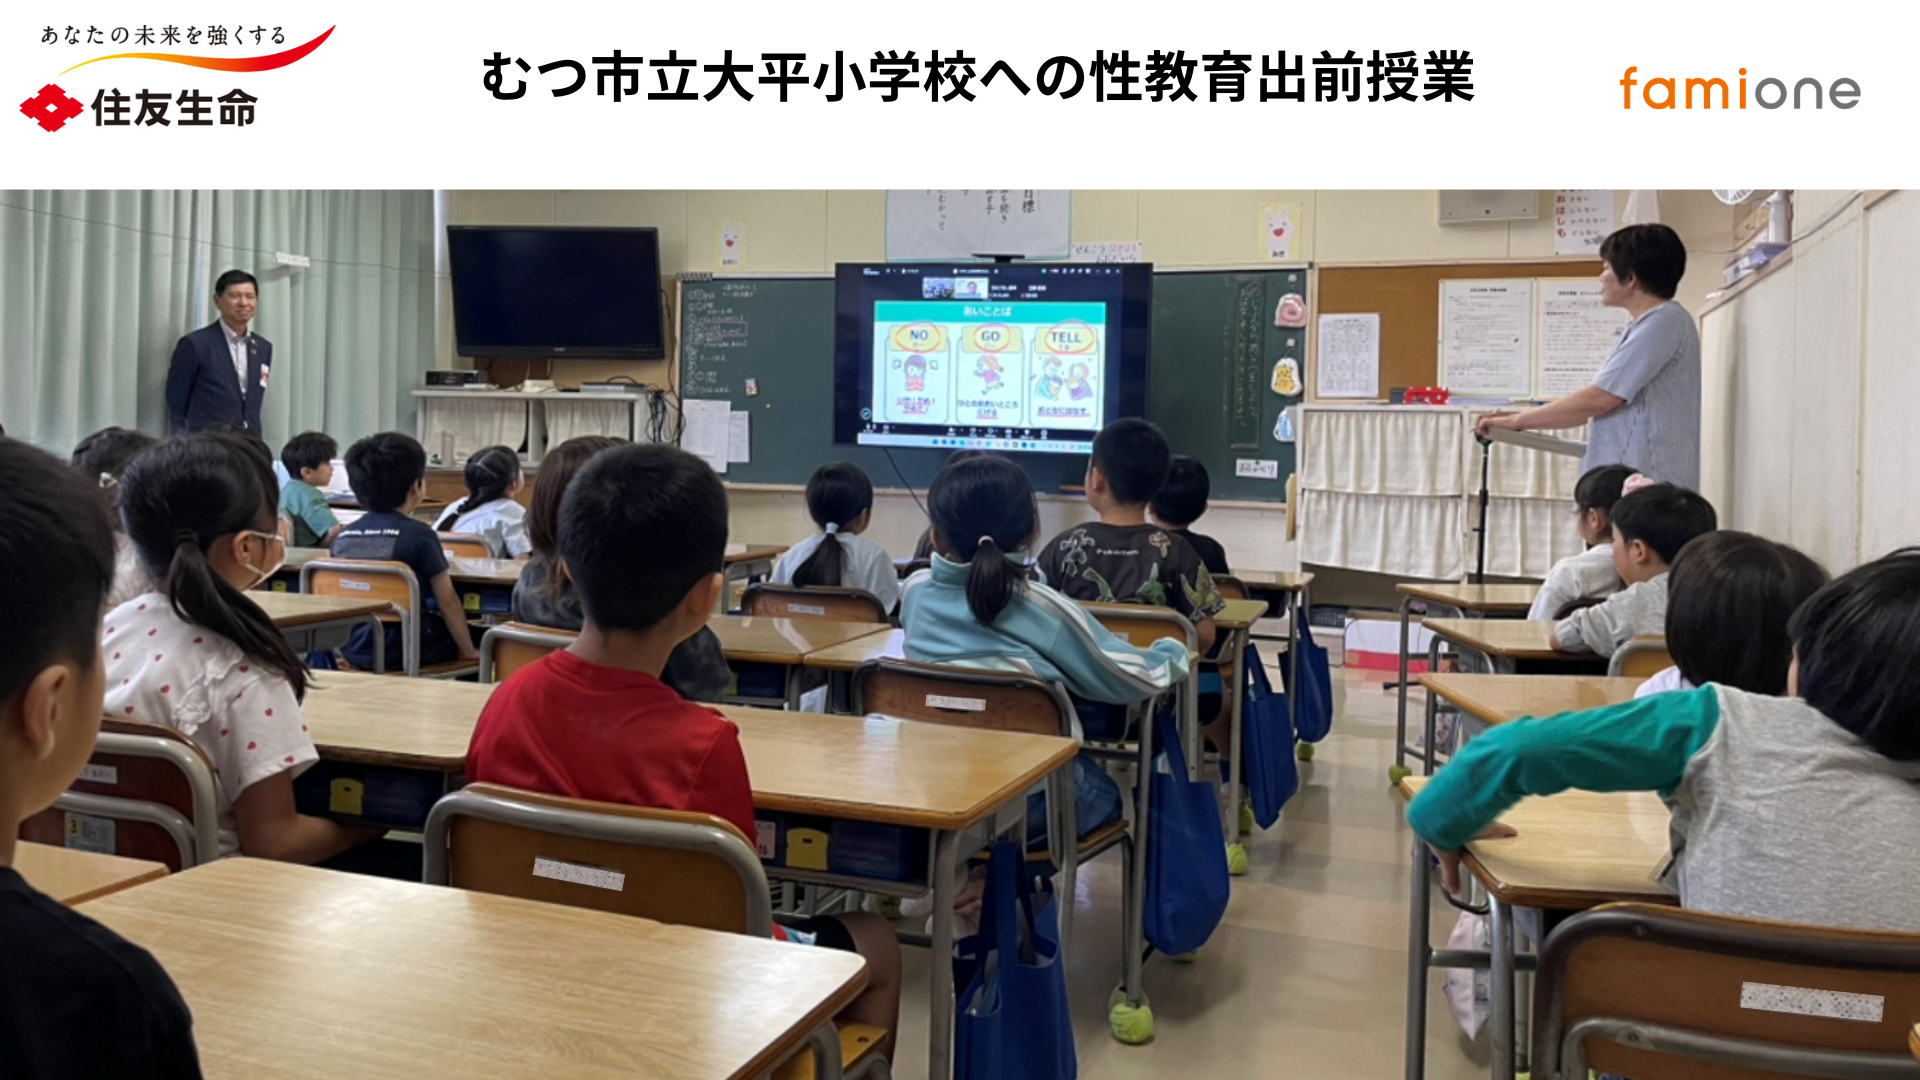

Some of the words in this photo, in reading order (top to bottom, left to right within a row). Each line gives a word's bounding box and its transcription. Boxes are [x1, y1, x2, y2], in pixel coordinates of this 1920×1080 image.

[910, 329, 929, 340] NO
[981, 331, 1001, 342] GO
[1052, 331, 1082, 343] TELL
